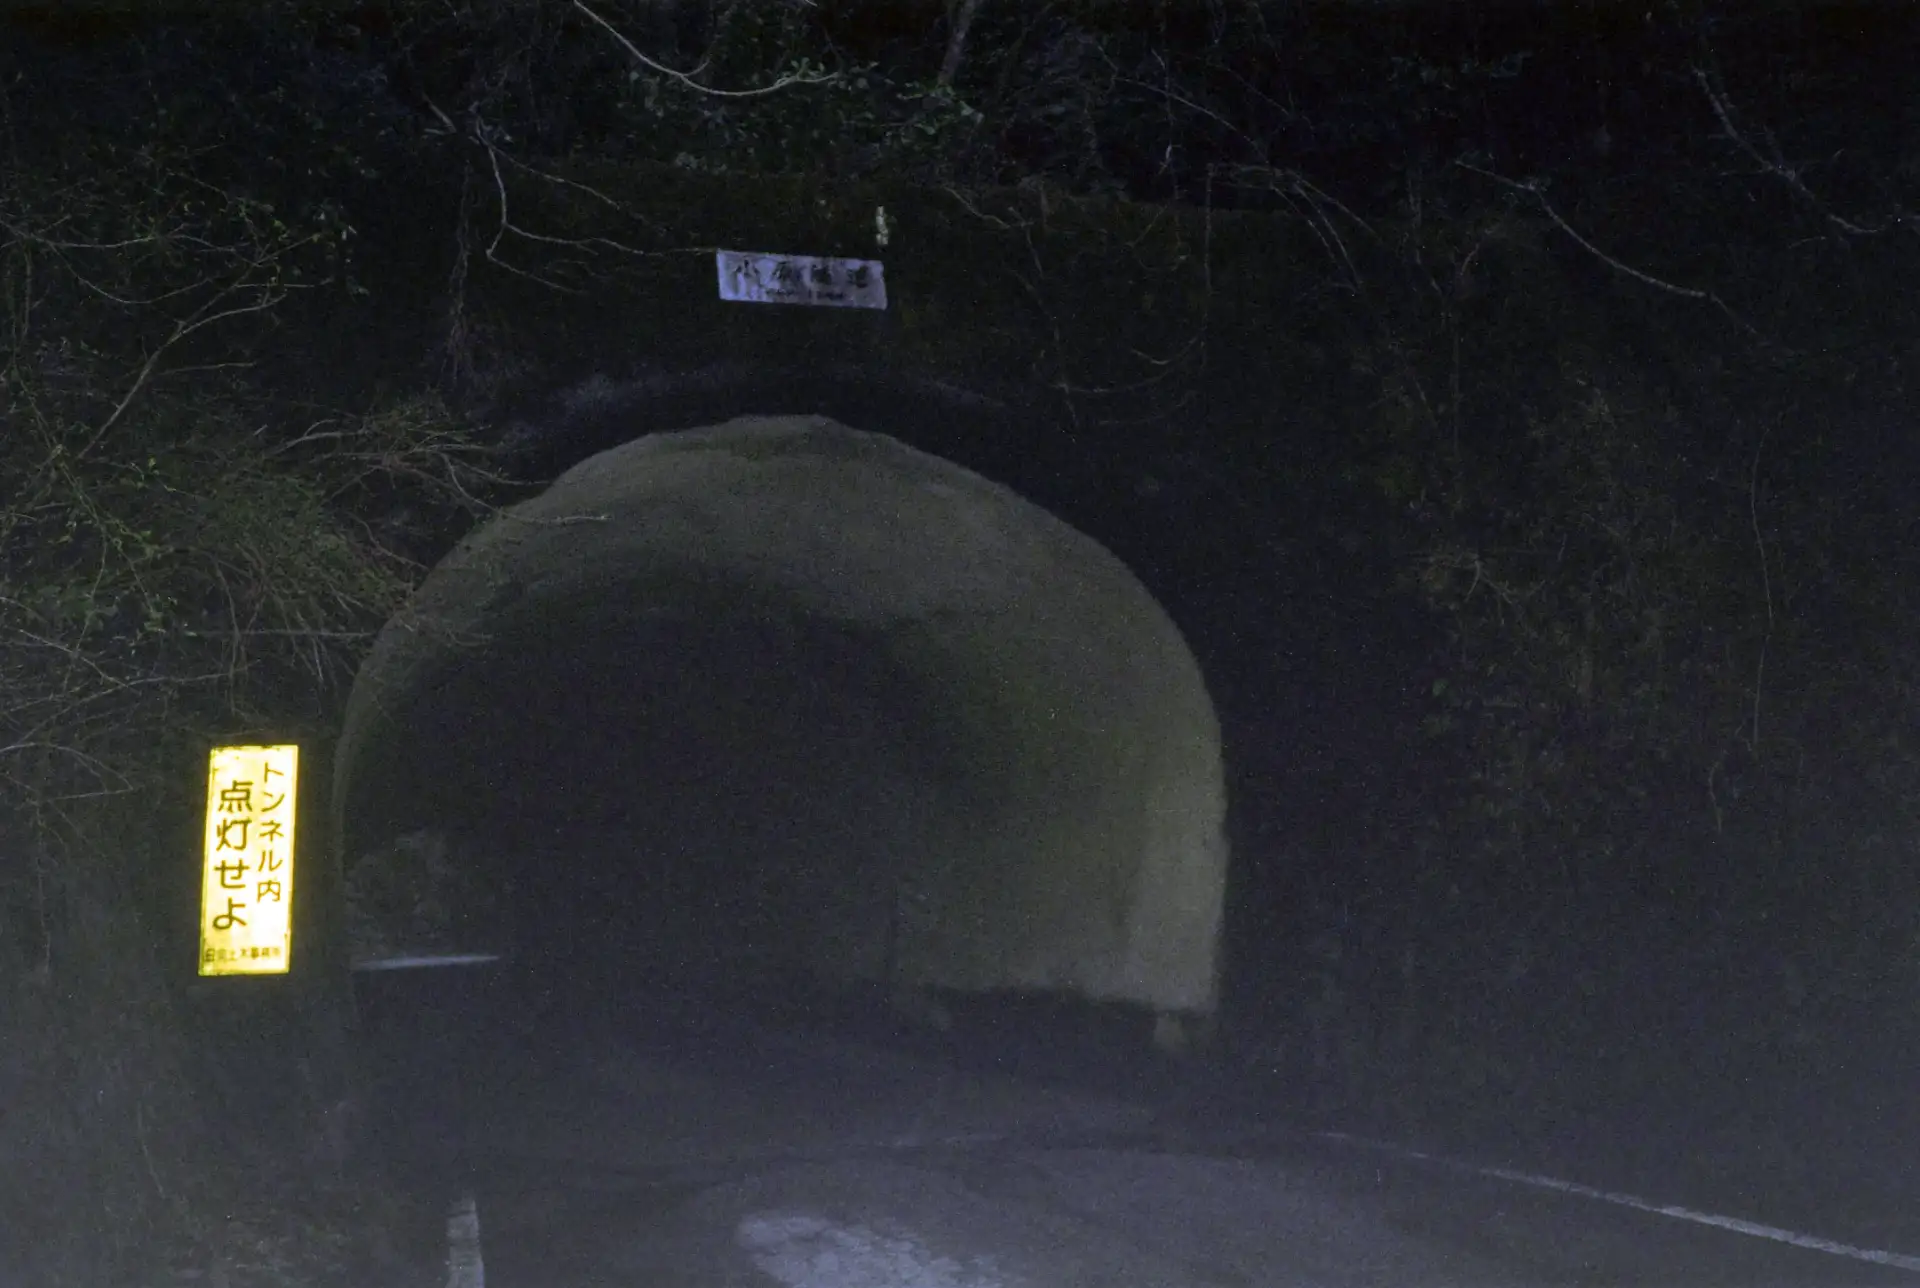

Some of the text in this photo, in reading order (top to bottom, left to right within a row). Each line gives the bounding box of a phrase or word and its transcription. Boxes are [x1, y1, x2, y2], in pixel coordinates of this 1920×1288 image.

[212, 779, 254, 931] 点灯せよ
[257, 762, 286, 903] トンネル内
